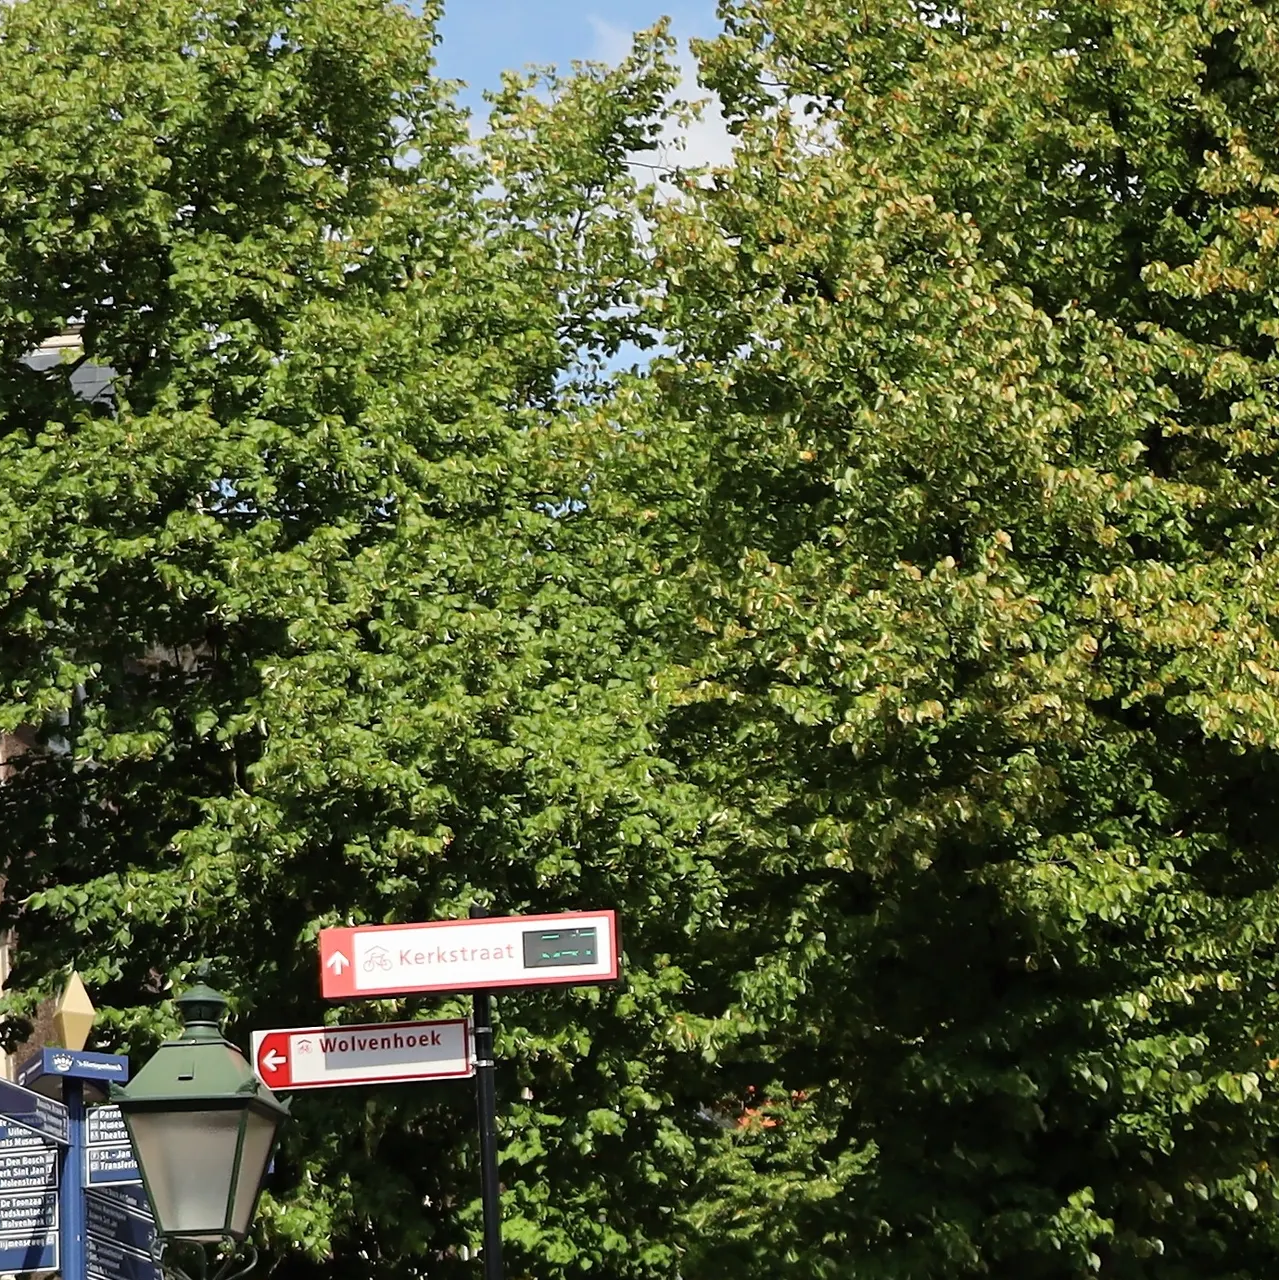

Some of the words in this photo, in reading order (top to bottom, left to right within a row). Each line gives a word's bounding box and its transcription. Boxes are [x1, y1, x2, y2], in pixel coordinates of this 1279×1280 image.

[399, 943, 515, 966] Kerkstraat
[319, 1030, 441, 1053] Wolvenhoek
[6, 1158, 21, 1167] Den
[22, 1156, 45, 1165] Bosch
[13, 1168, 29, 1177] Sint
[30, 1167, 45, 1175] Jan
[0, 1177, 45, 1188] Molenstraat
[0, 1199, 11, 1208] De
[2, 1219, 44, 1229] Wolvenhoek
